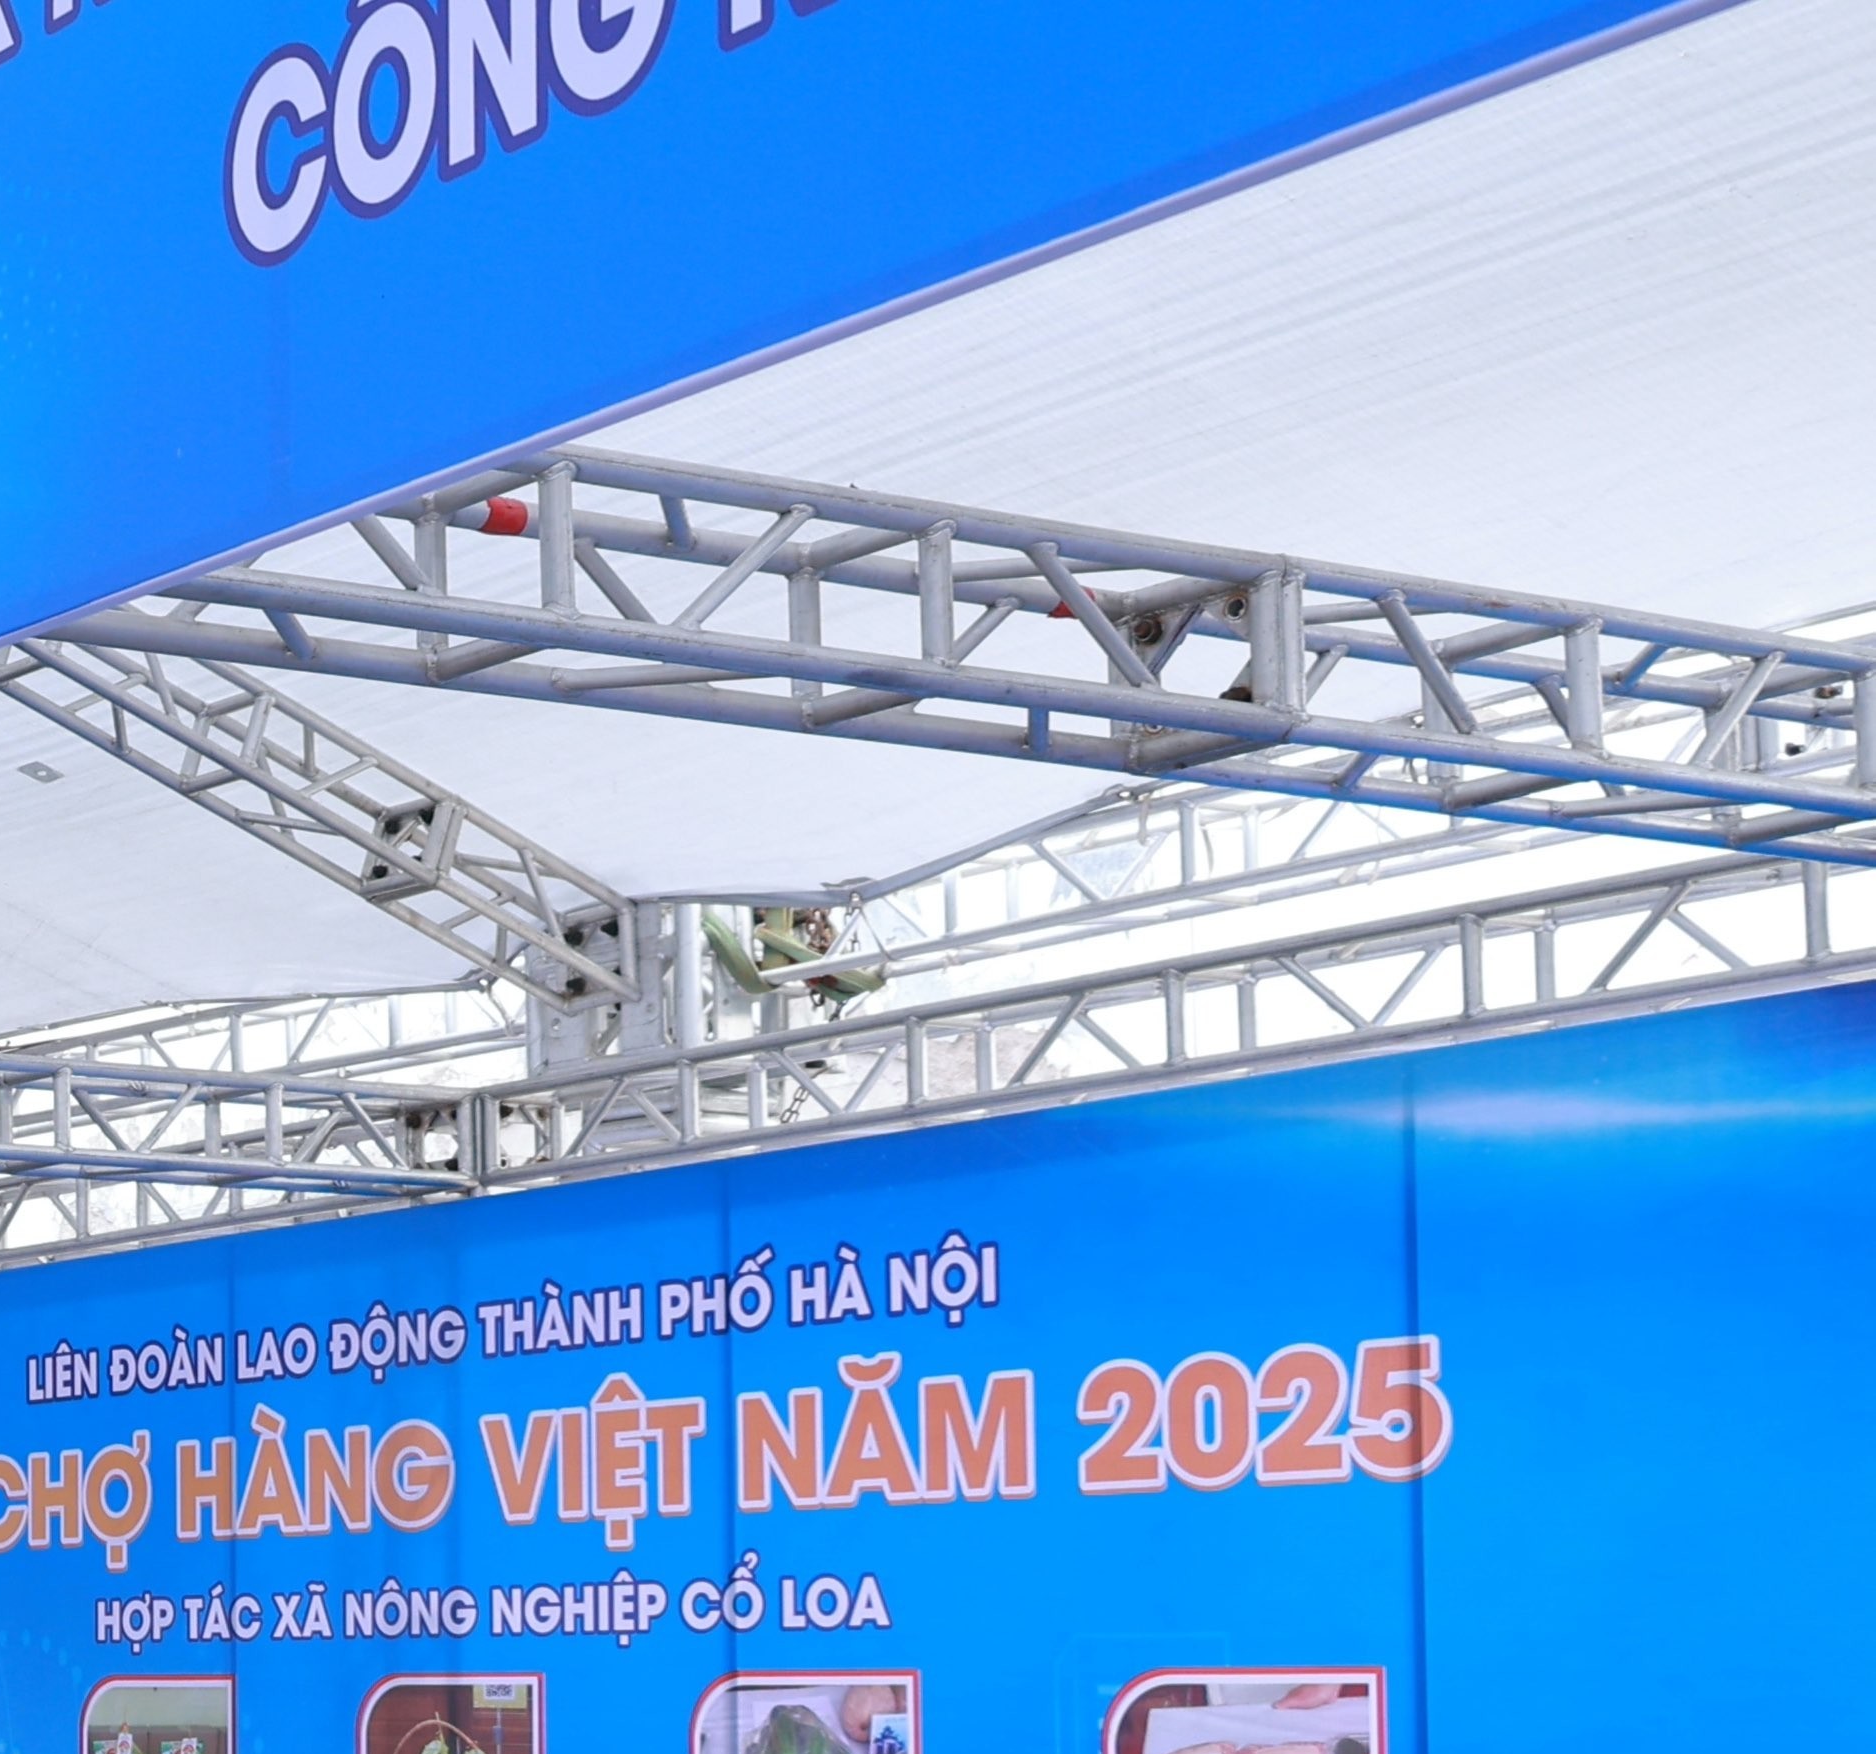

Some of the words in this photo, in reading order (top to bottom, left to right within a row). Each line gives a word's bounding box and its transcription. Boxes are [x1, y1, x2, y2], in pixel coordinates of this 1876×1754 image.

[25, 1340, 101, 1406] LIÊN
[109, 1325, 227, 1396] ĐOÀN
[235, 1328, 317, 1382] LAO
[329, 1301, 468, 1389] ĐỘNG
[477, 1281, 646, 1357] THÀNH
[658, 1247, 774, 1342] PHỐ
[788, 1246, 872, 1326] HÀ
[888, 1231, 1000, 1328] NỘI
[175, 1402, 454, 1543] HÀNG
[479, 1371, 707, 1551] VIỆT
[736, 1350, 1037, 1512] NĂM
[1076, 1333, 1453, 1496] 2025
[95, 1579, 176, 1654] HỢP
[181, 1582, 261, 1645] TÁC
[273, 1579, 334, 1643] XÃ
[343, 1577, 478, 1640] NÔNG
[491, 1567, 668, 1648] NGHIỆP
[679, 1550, 767, 1633] CỔ
[779, 1573, 892, 1633] LOA
